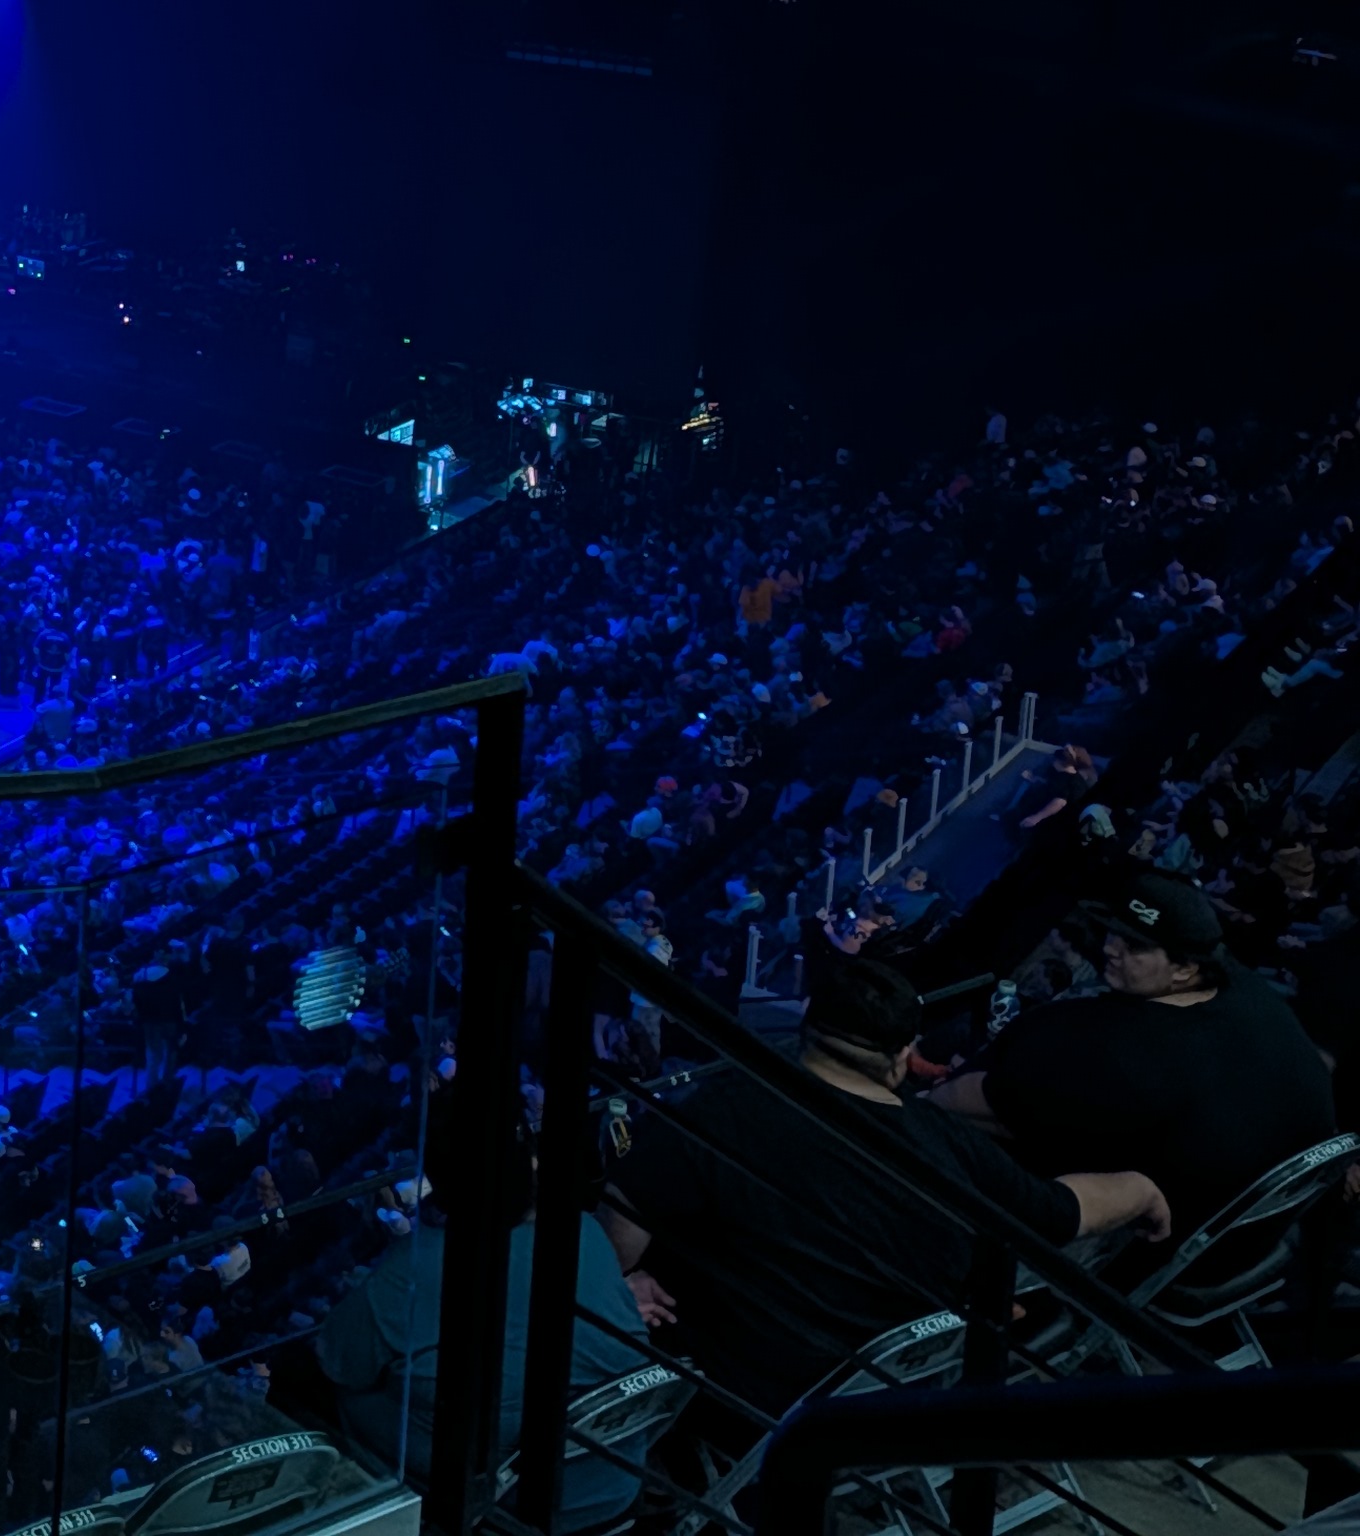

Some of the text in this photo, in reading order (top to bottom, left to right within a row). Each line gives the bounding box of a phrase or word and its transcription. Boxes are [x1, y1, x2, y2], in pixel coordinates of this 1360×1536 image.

[1302, 1142, 1342, 1166] SECTION
[910, 1313, 962, 1339] SECTION
[619, 1366, 668, 1396] SECTION
[231, 1435, 313, 1463] SECTION 311
[17, 1509, 96, 1536] CTIN 311
